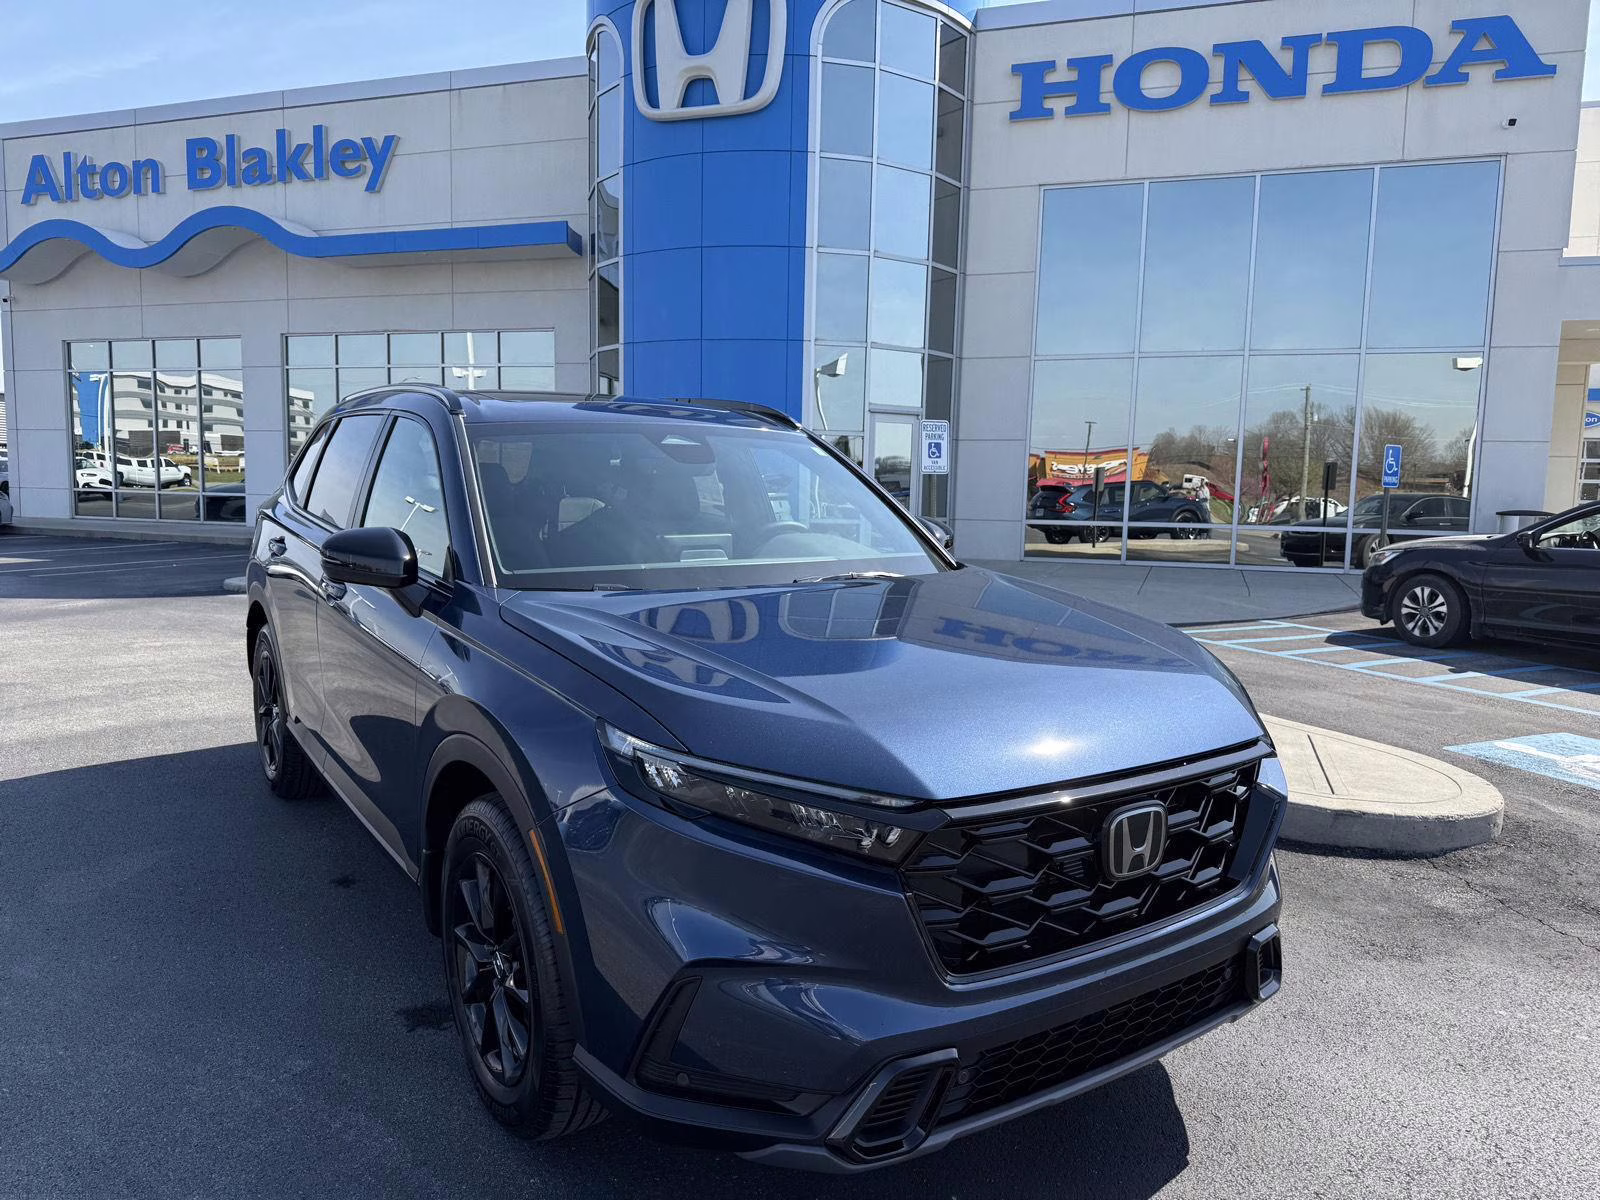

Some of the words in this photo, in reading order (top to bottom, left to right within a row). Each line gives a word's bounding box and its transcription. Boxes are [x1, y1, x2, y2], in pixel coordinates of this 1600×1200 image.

[1009, 15, 1558, 121] HONDA
[21, 151, 165, 205] Alton
[186, 124, 400, 194] Blakley
[922, 424, 946, 432] RESERVED
[924, 433, 945, 441] PARKING
